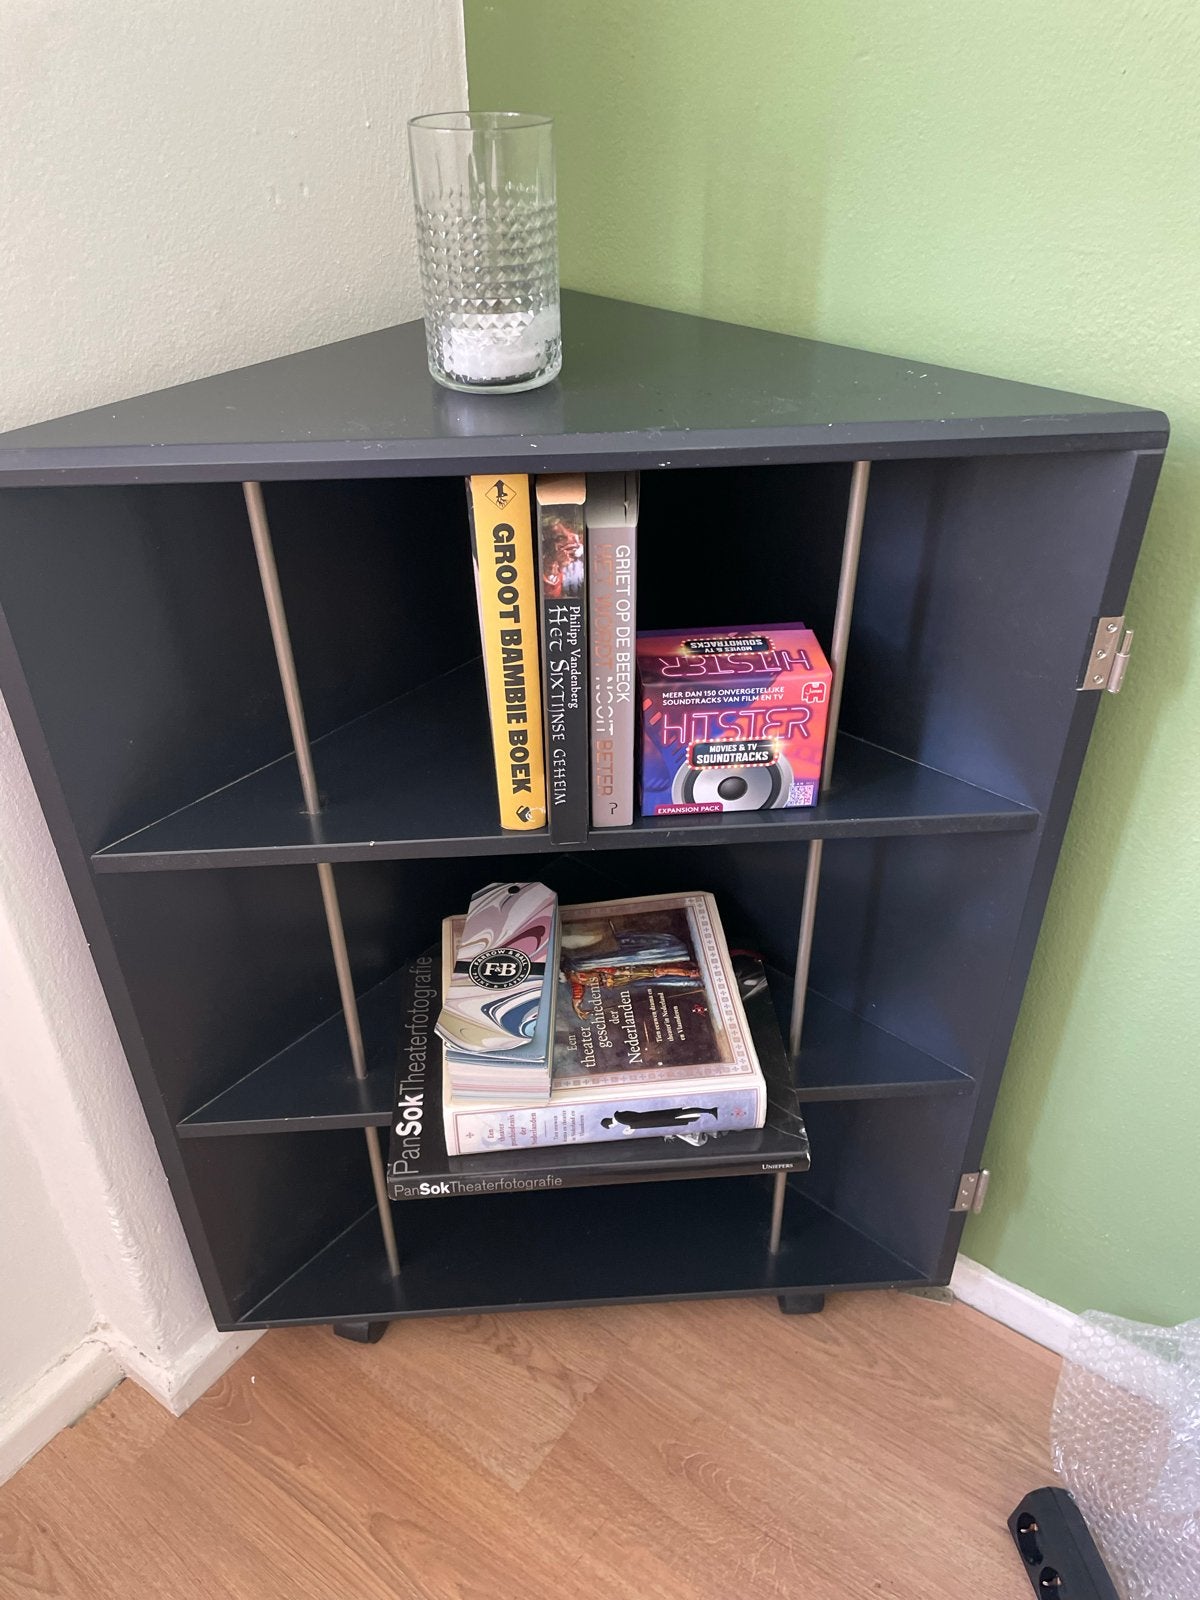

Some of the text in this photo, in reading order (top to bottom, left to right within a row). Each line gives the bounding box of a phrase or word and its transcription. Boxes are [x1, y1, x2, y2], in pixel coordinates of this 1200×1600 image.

[592, 543, 613, 587] HET
[593, 593, 613, 669] WORDT
[615, 545, 632, 703] GRIET OP DE BEECK
[690, 639, 763, 649] SOUNDTRACKS
[492, 522, 530, 795] GROOT BAMBIE BOEK
[567, 605, 582, 709] Philipp Vandenberg
[658, 650, 811, 677] HITSTER
[662, 690, 683, 699] MEER
[704, 689, 716, 697] 150
[718, 686, 785, 696] ONVERGETELIJKE
[662, 697, 722, 706] SOUNDTRACKS
[663, 707, 810, 746] HITSTER
[696, 751, 769, 764] SOUNDTRACKS
[709, 744, 737, 752] MOVIES
[747, 743, 758, 751] TV
[597, 739, 614, 797] BETER
[658, 804, 720, 814] EXPANSION PACK
[474, 949, 506, 966] FARROW
[515, 953, 528, 966] BALL
[588, 976, 613, 1048] geschiedenis
[648, 995, 657, 1011] drama
[658, 992, 669, 1017] Nederland
[608, 1010, 620, 1024] der
[618, 990, 643, 1064] Nederlanden
[566, 1035, 578, 1051] Een
[655, 1030, 663, 1043] Tien
[664, 1023, 674, 1042] theater
[579, 1026, 597, 1068] theater
